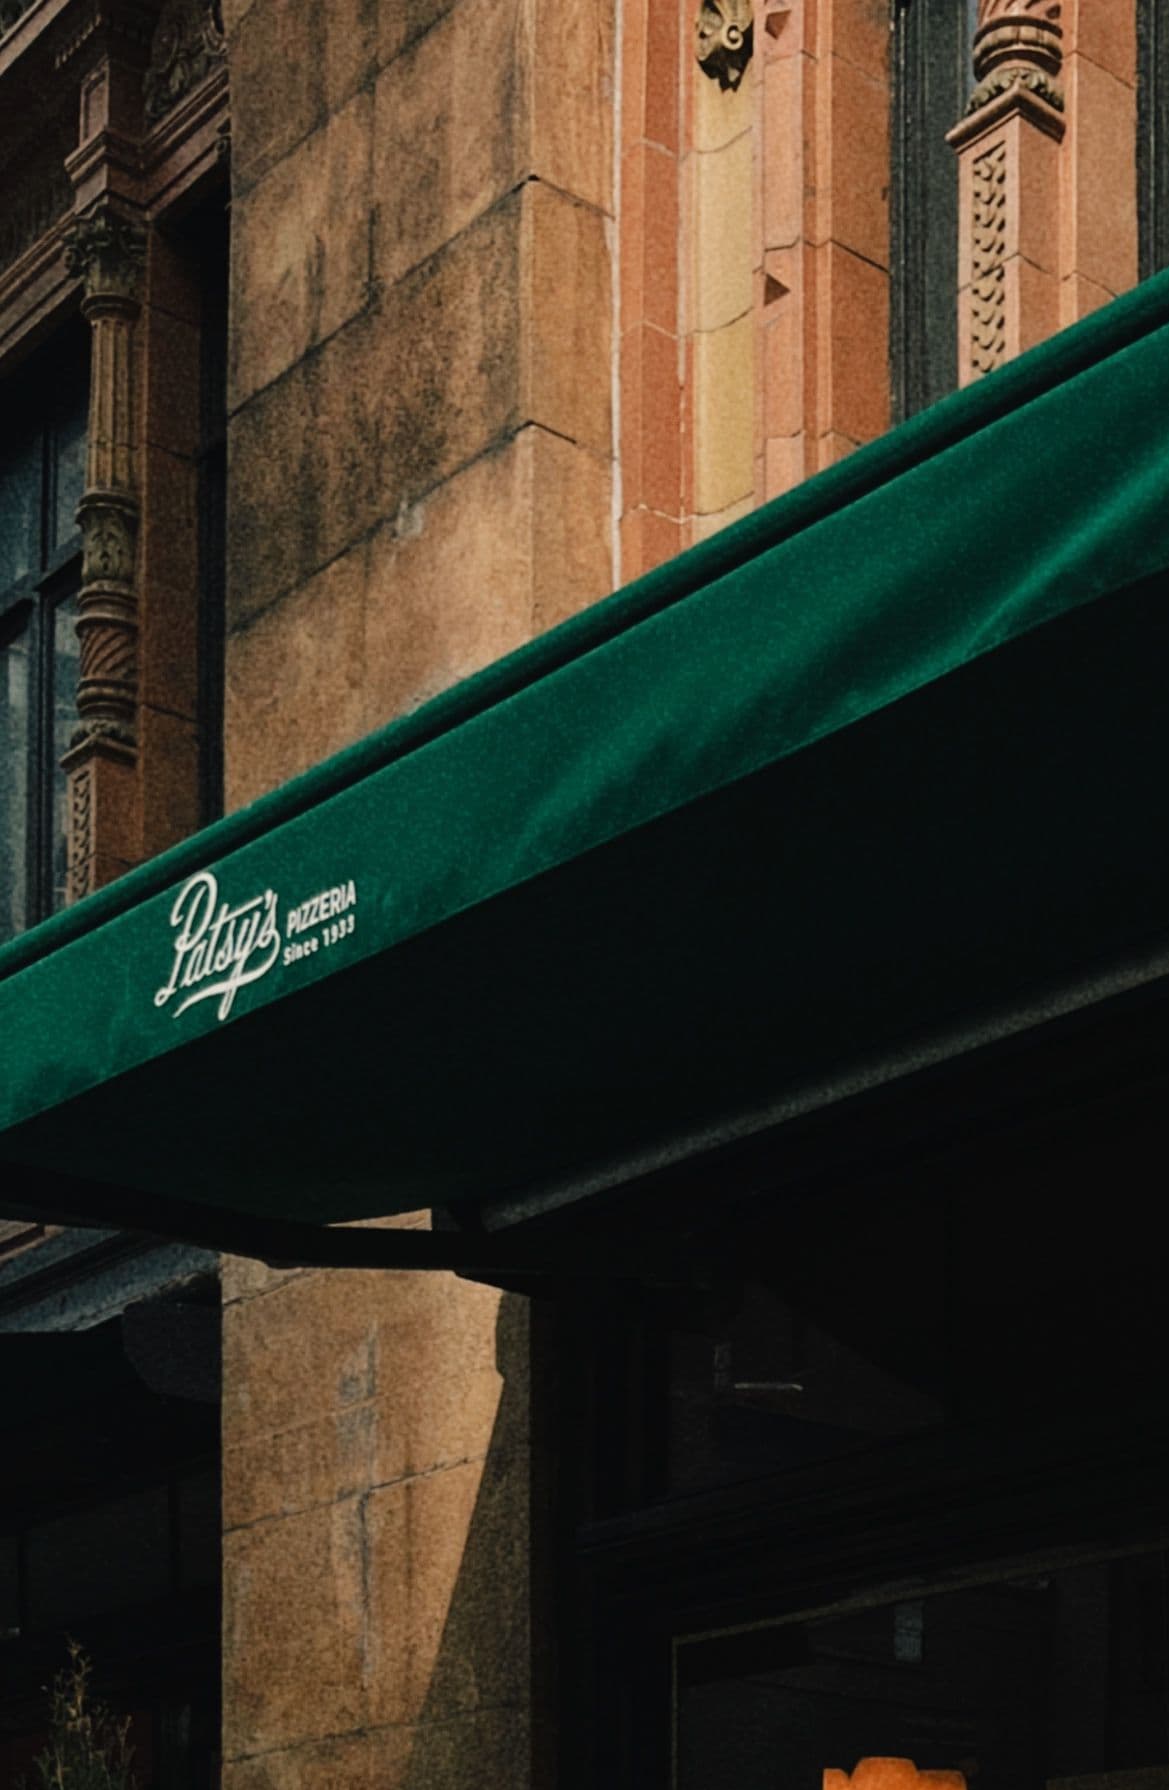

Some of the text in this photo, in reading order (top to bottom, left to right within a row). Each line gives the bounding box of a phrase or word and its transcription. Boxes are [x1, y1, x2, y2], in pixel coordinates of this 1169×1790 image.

[286, 879, 357, 938] PIZZERIA
[154, 870, 281, 1021] Patsy's
[283, 913, 355, 966] Since 1933
